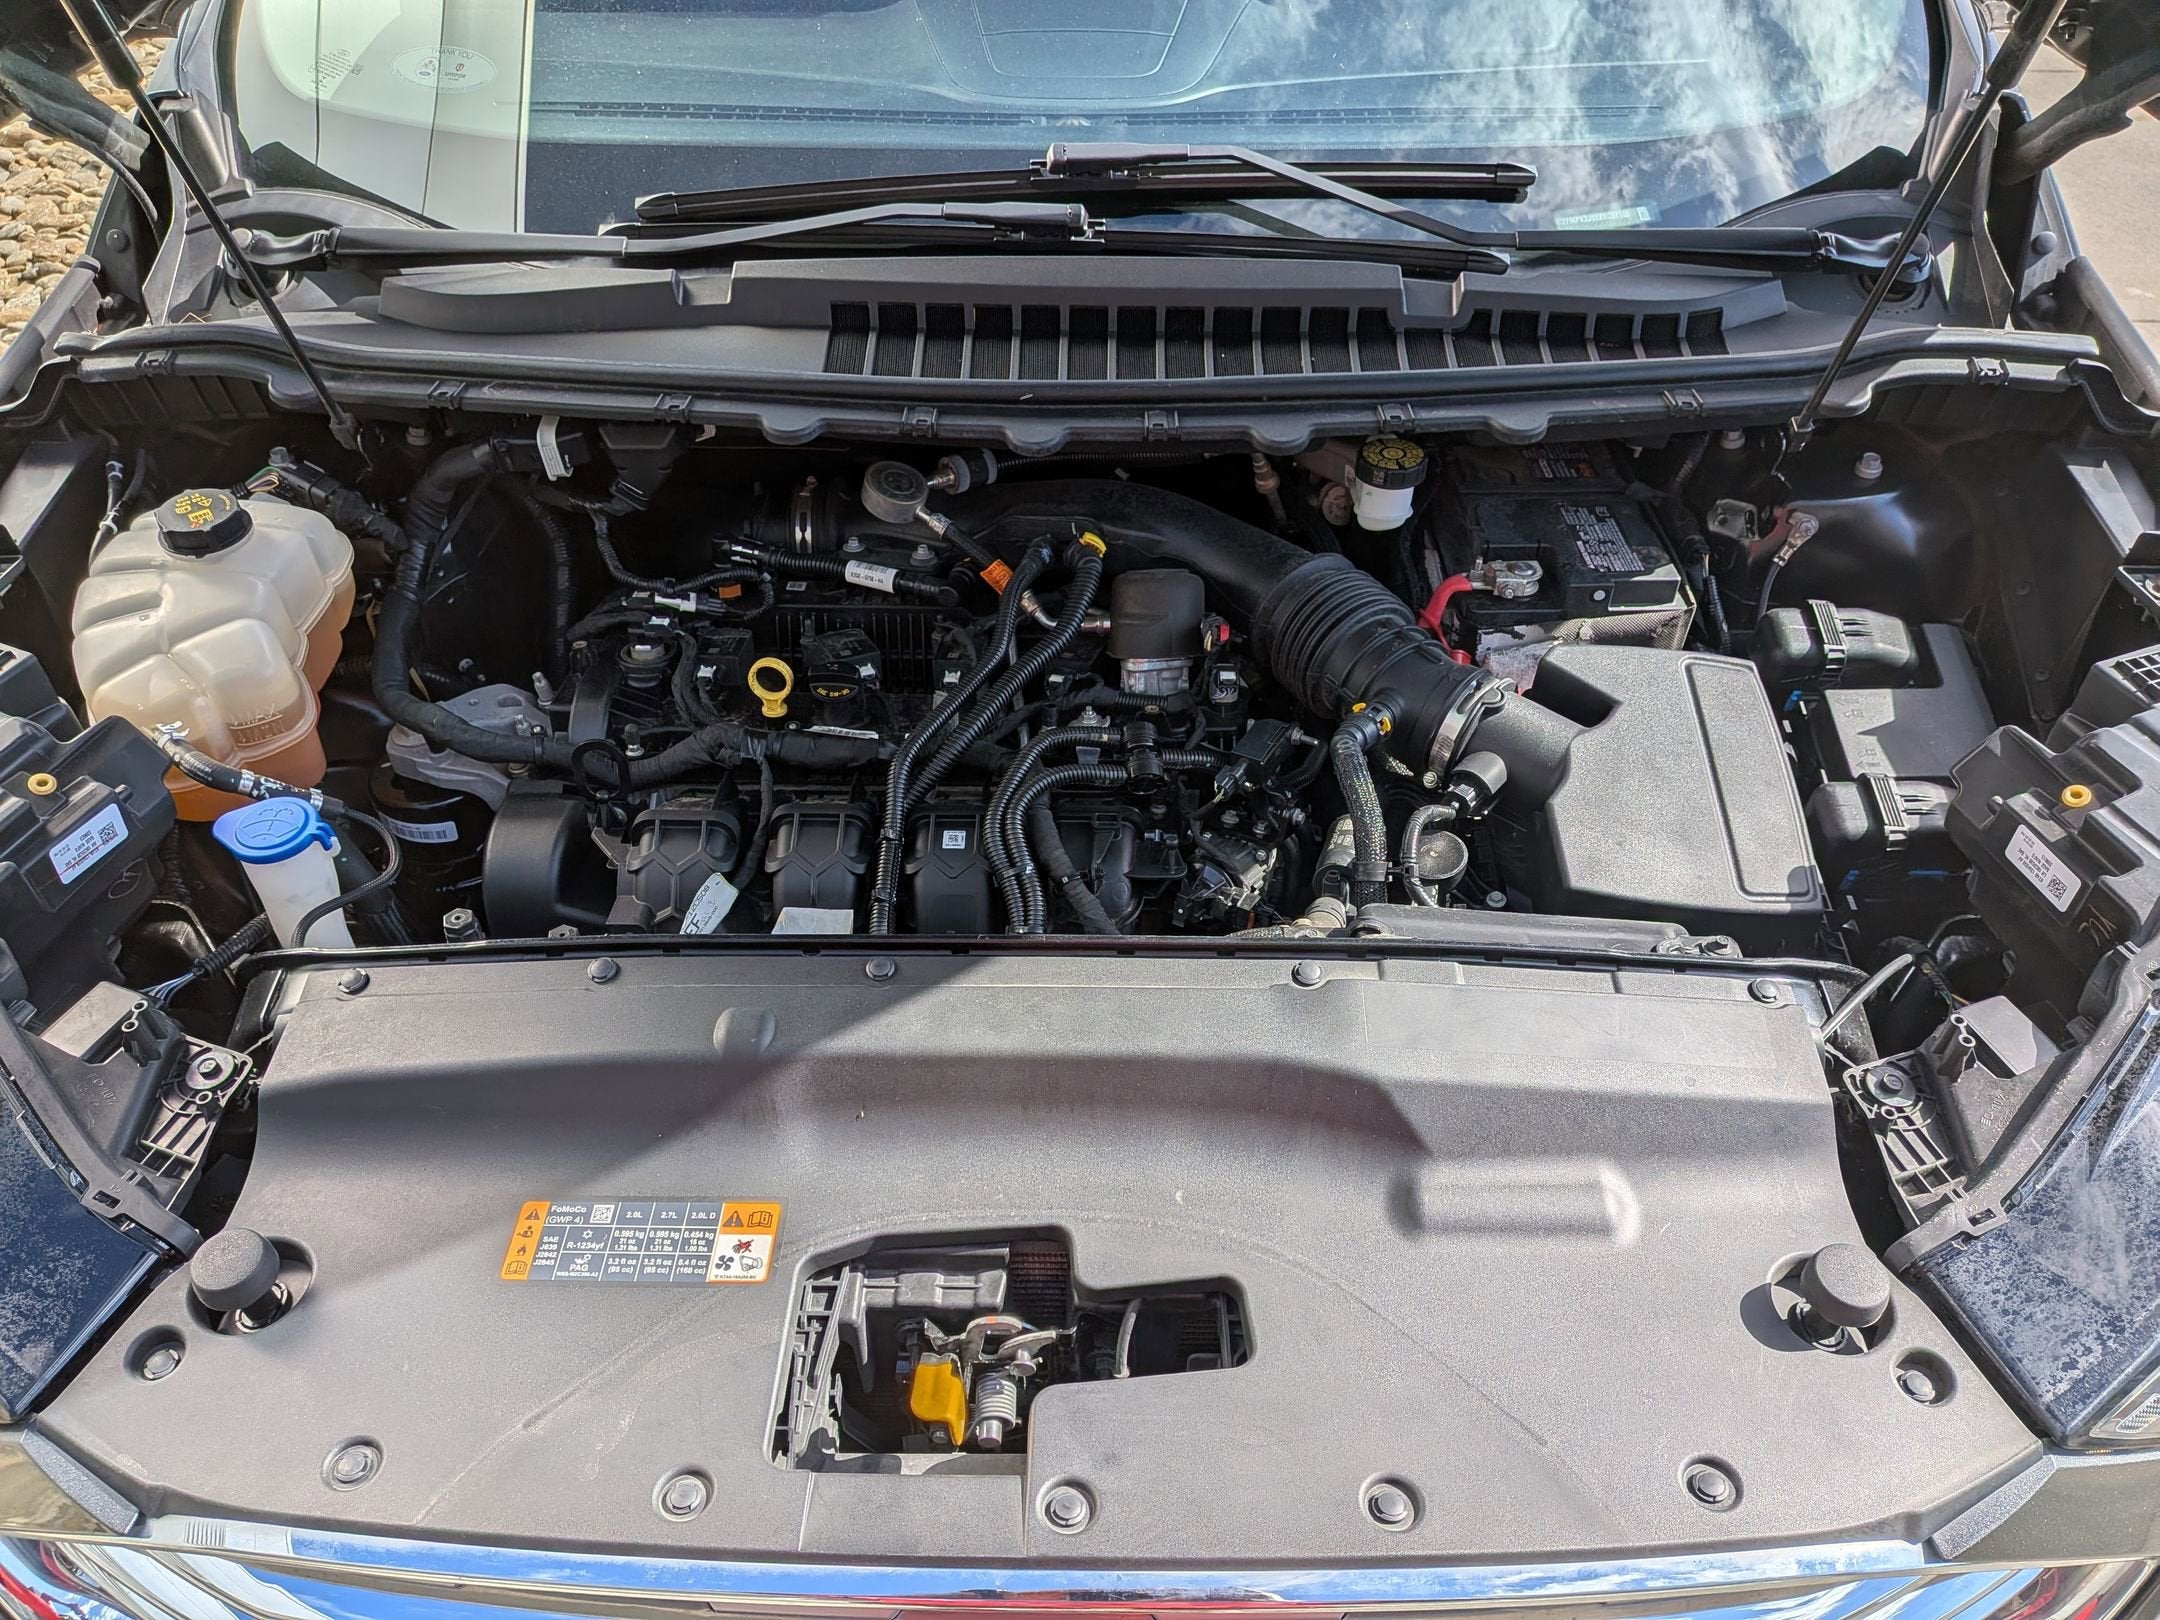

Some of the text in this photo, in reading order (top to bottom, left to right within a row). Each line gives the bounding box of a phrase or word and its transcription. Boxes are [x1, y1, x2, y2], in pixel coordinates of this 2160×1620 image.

[456, 50, 474, 60] YOU
[545, 1216, 584, 1224] (GWP 4)
[635, 1230, 645, 1239] kg
[670, 1230, 680, 1239] kg
[705, 1231, 714, 1240] kg
[566, 1242, 605, 1250] R-1234yf
